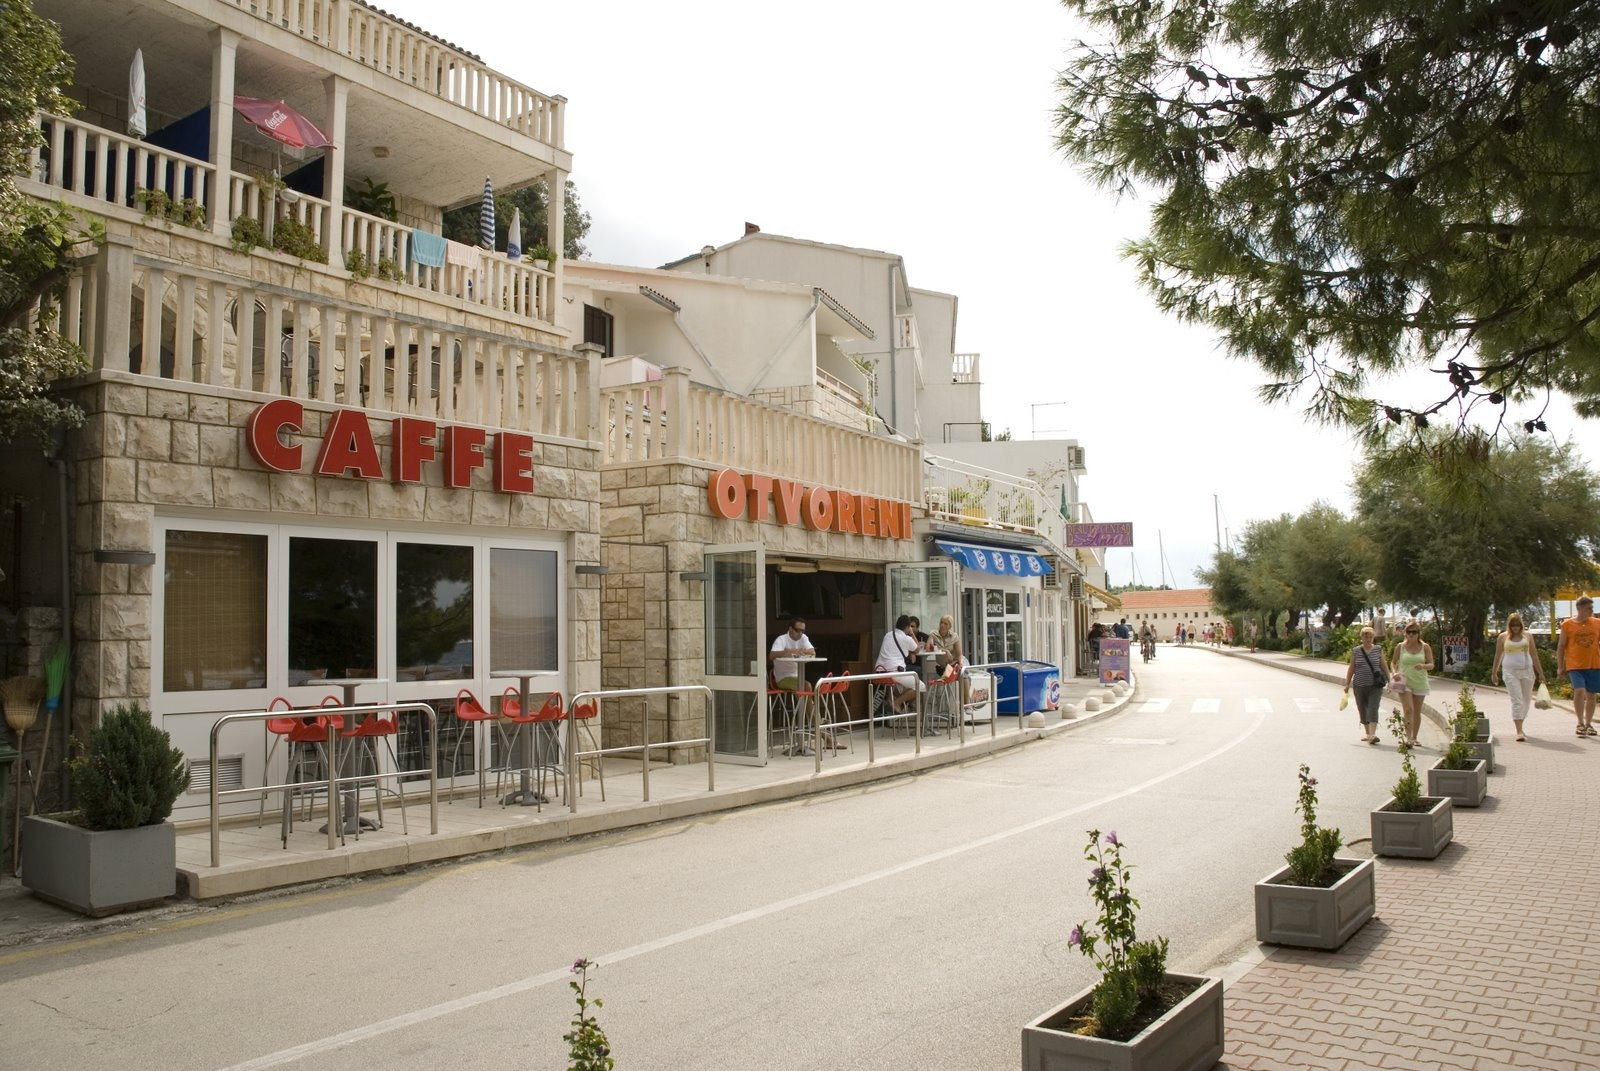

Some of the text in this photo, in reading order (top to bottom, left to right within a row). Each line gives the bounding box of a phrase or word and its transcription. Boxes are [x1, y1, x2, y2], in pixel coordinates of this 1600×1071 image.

[246, 399, 534, 493] CAFFE
[708, 468, 912, 541] OTVORENI
[1455, 653, 1467, 661] CLUB
